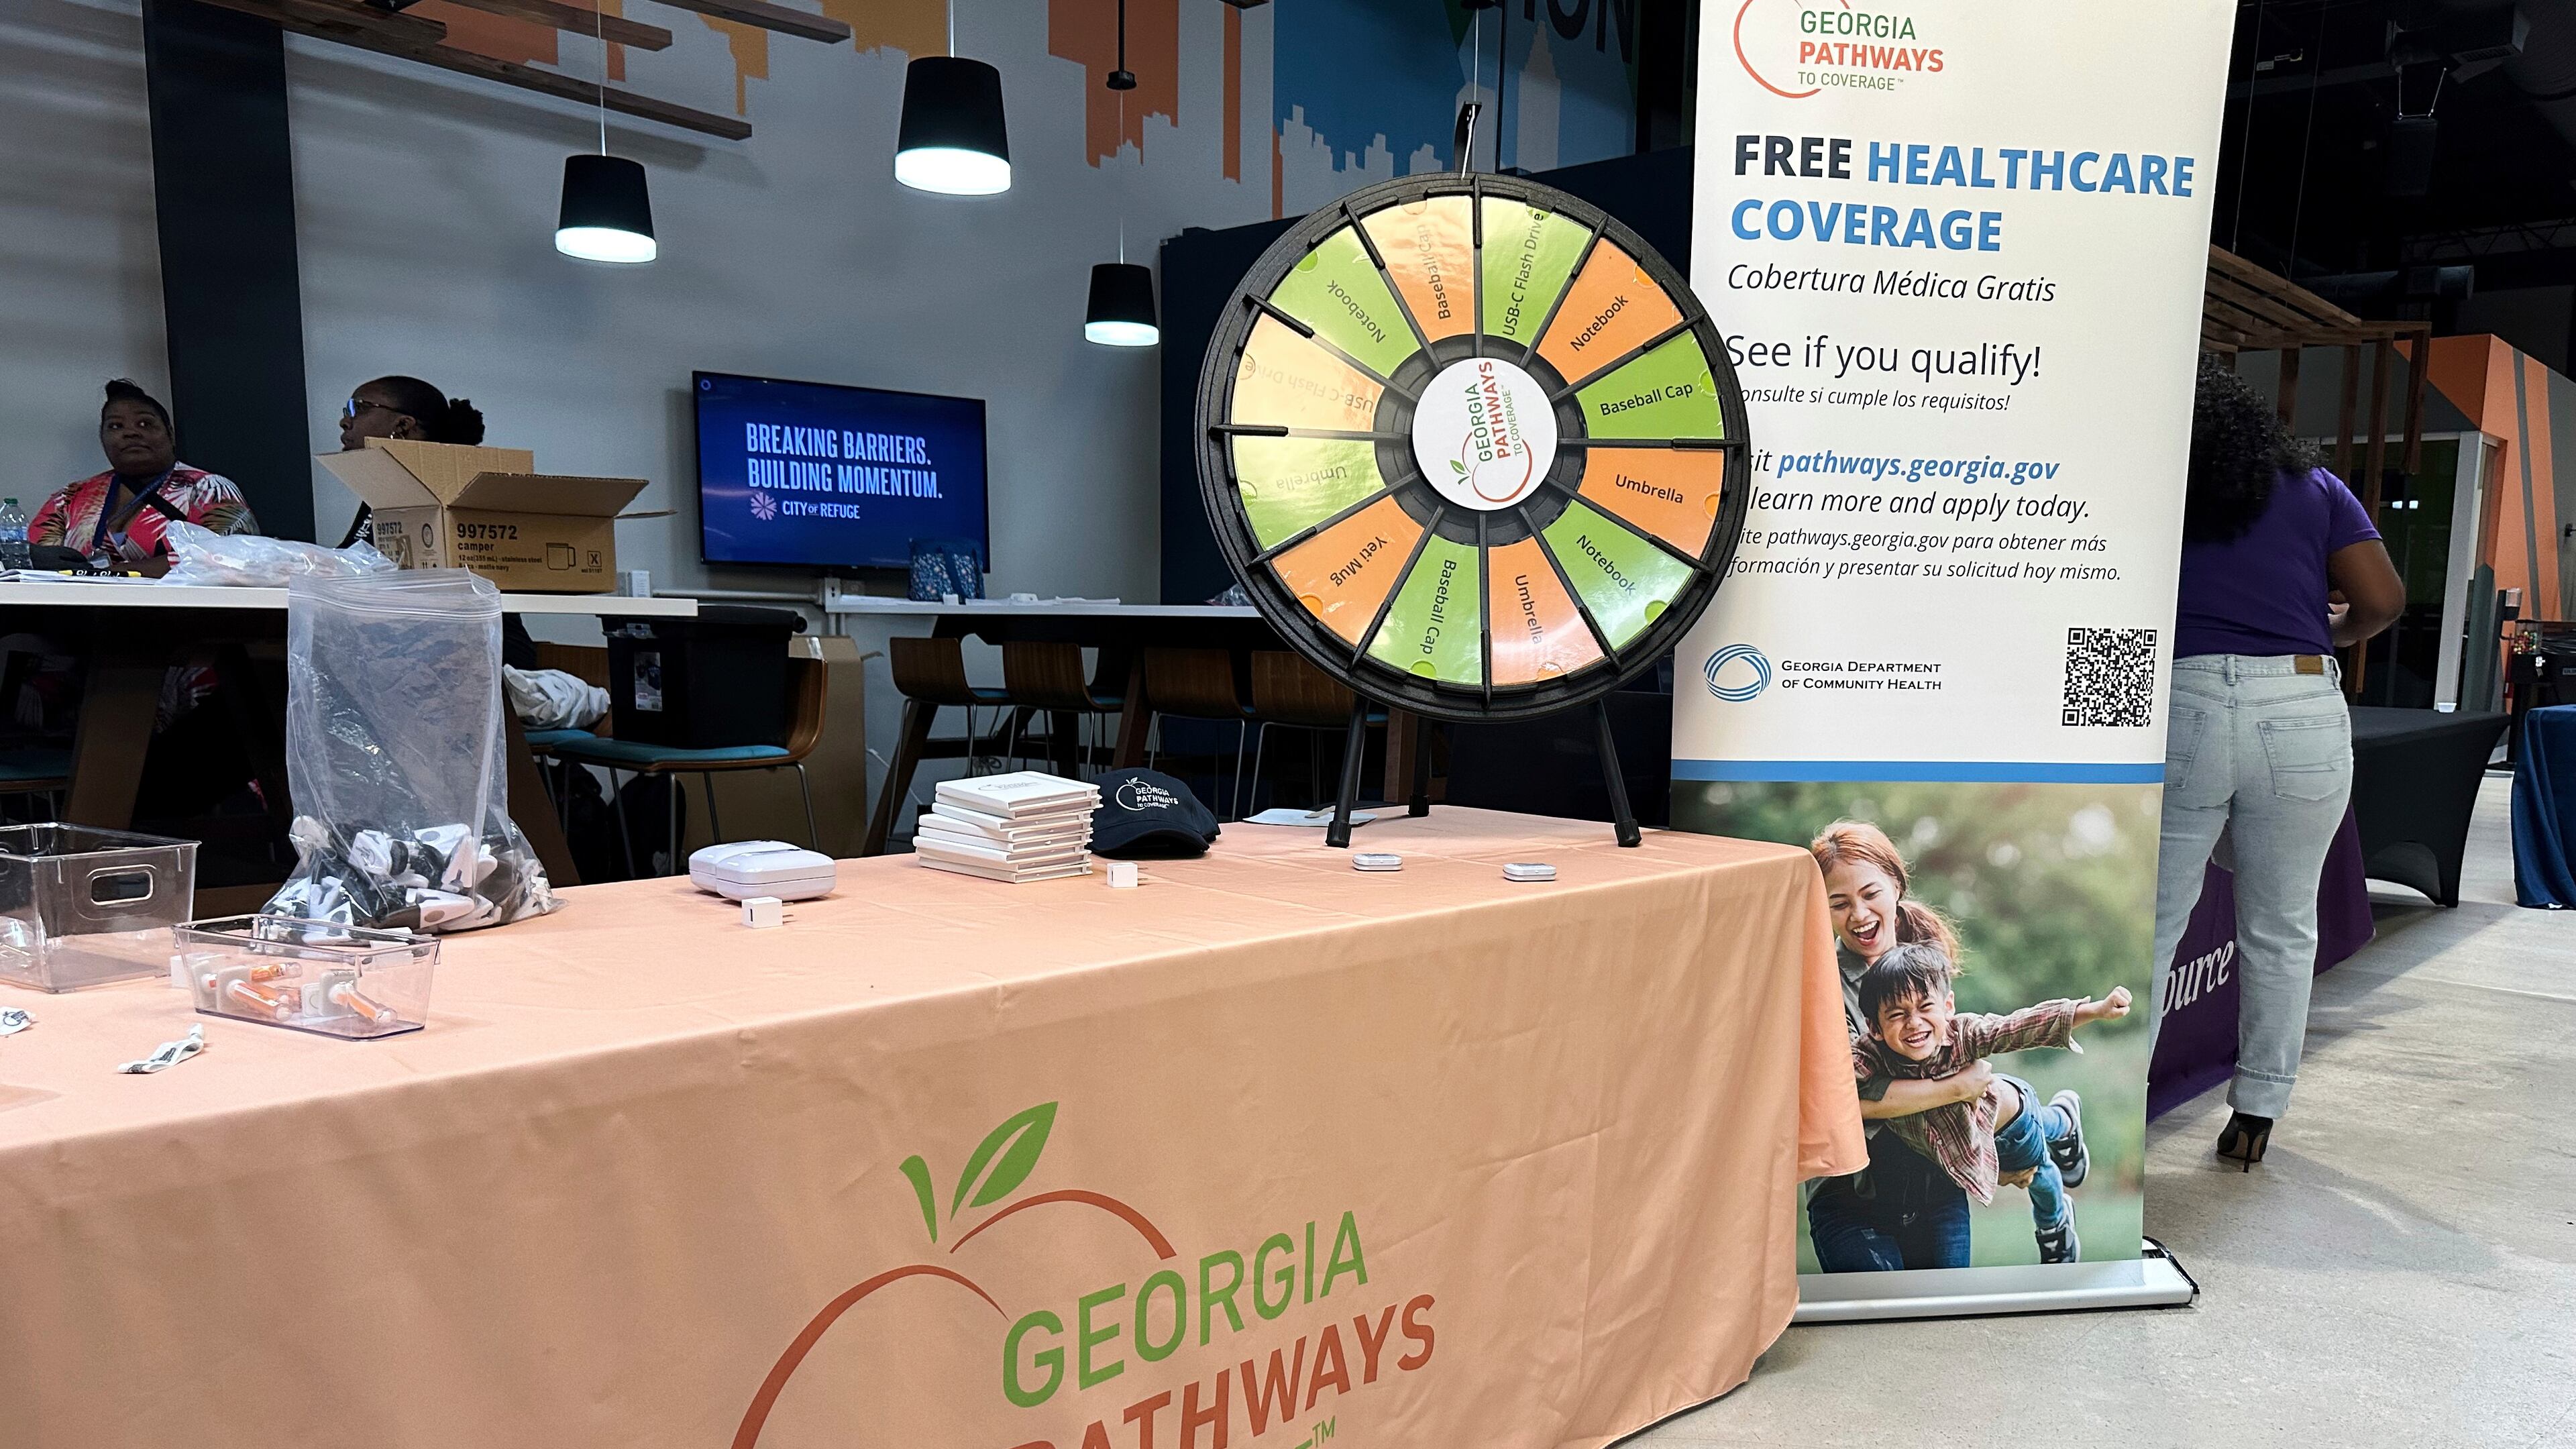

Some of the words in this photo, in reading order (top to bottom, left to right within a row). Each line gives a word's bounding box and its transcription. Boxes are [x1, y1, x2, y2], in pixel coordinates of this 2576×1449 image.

[1801, 10, 1916, 40] GEORGIA
[1799, 41, 1943, 72] PATHWAYS
[1798, 71, 1815, 85] TO
[1734, 135, 1851, 180] FREE
[1868, 141, 2195, 197] HEALTHCARE
[1417, 225, 1432, 252] Cap
[1731, 199, 2002, 252] COVERAGE
[1422, 256, 1451, 319] Baseball
[1503, 292, 1524, 336] USB-C
[1514, 255, 1534, 290] Flash
[1524, 213, 1544, 251] Drive
[1727, 263, 1865, 294] Cobertura
[1872, 268, 1968, 299] Médica
[1976, 274, 2055, 303] Gratis
[1327, 279, 1386, 343] Notebook
[1570, 295, 1629, 352] Notebook
[1726, 335, 1791, 368] See
[1805, 335, 1829, 368] if
[1834, 345, 1898, 378] you
[1911, 343, 2041, 386] qualify!
[1332, 388, 1374, 413] USB-C
[1479, 362, 1511, 459] PATHWAYS
[1599, 388, 1662, 416] Baseball
[1665, 384, 1693, 398] Cap
[1741, 385, 1805, 402] onsulte
[1809, 387, 1824, 403] si
[1827, 388, 1888, 410] cumple
[1892, 389, 1916, 408] los
[1921, 392, 2011, 413] requisitos!
[1464, 383, 1493, 462] GEORGIA
[746, 423, 838, 459] BREAKING
[843, 431, 931, 465] BARRIERS.
[1513, 443, 1523, 456] TO
[748, 458, 832, 492] BUILDING
[838, 464, 943, 498] MOMENTUM.
[1277, 466, 1347, 492] Umbrella
[1777, 451, 2060, 486] pathways.georgia.gov
[1615, 474, 1684, 504] Umbrella
[783, 500, 808, 516] CITY
[820, 503, 860, 519] REFUGE
[1750, 486, 1813, 511] learn
[1821, 493, 1882, 513] more
[1889, 488, 1936, 515] and
[1942, 492, 2009, 524] apply
[2017, 494, 2090, 523] today.
[457, 523, 518, 540] 997572
[1767, 529, 1949, 551] pathways.georgia.gov
[1952, 536, 1995, 552] para
[1998, 534, 2067, 553] obtener
[2071, 535, 2107, 553] más
[458, 543, 494, 553] camper
[1359, 536, 1388, 563] Yeti
[1330, 557, 1363, 587] Mug
[1576, 534, 1636, 596] Notebook
[1727, 556, 1820, 580] formación
[1823, 561, 1836, 580] y
[1838, 560, 1919, 581] presentar
[1923, 564, 1942, 578] su
[1946, 560, 2019, 579] solicitud
[2023, 561, 2056, 582] hoy
[2059, 564, 2121, 581] mismo.
[1431, 559, 1457, 623] Baseball
[1515, 574, 1544, 645] Umbrella
[1419, 626, 1440, 655] Cap
[1782, 661, 1843, 672] GEORGIA
[1848, 661, 1941, 673] DEPARTMENT
[1803, 678, 1884, 690] COMMUNITY
[1888, 679, 1941, 690] HEALTH
[1136, 787, 1170, 796] GEORGIA
[1136, 795, 1179, 804] PATHWAYS
[2162, 940, 2235, 1018] ource
[1002, 1210, 1368, 1408] GEORGIA
